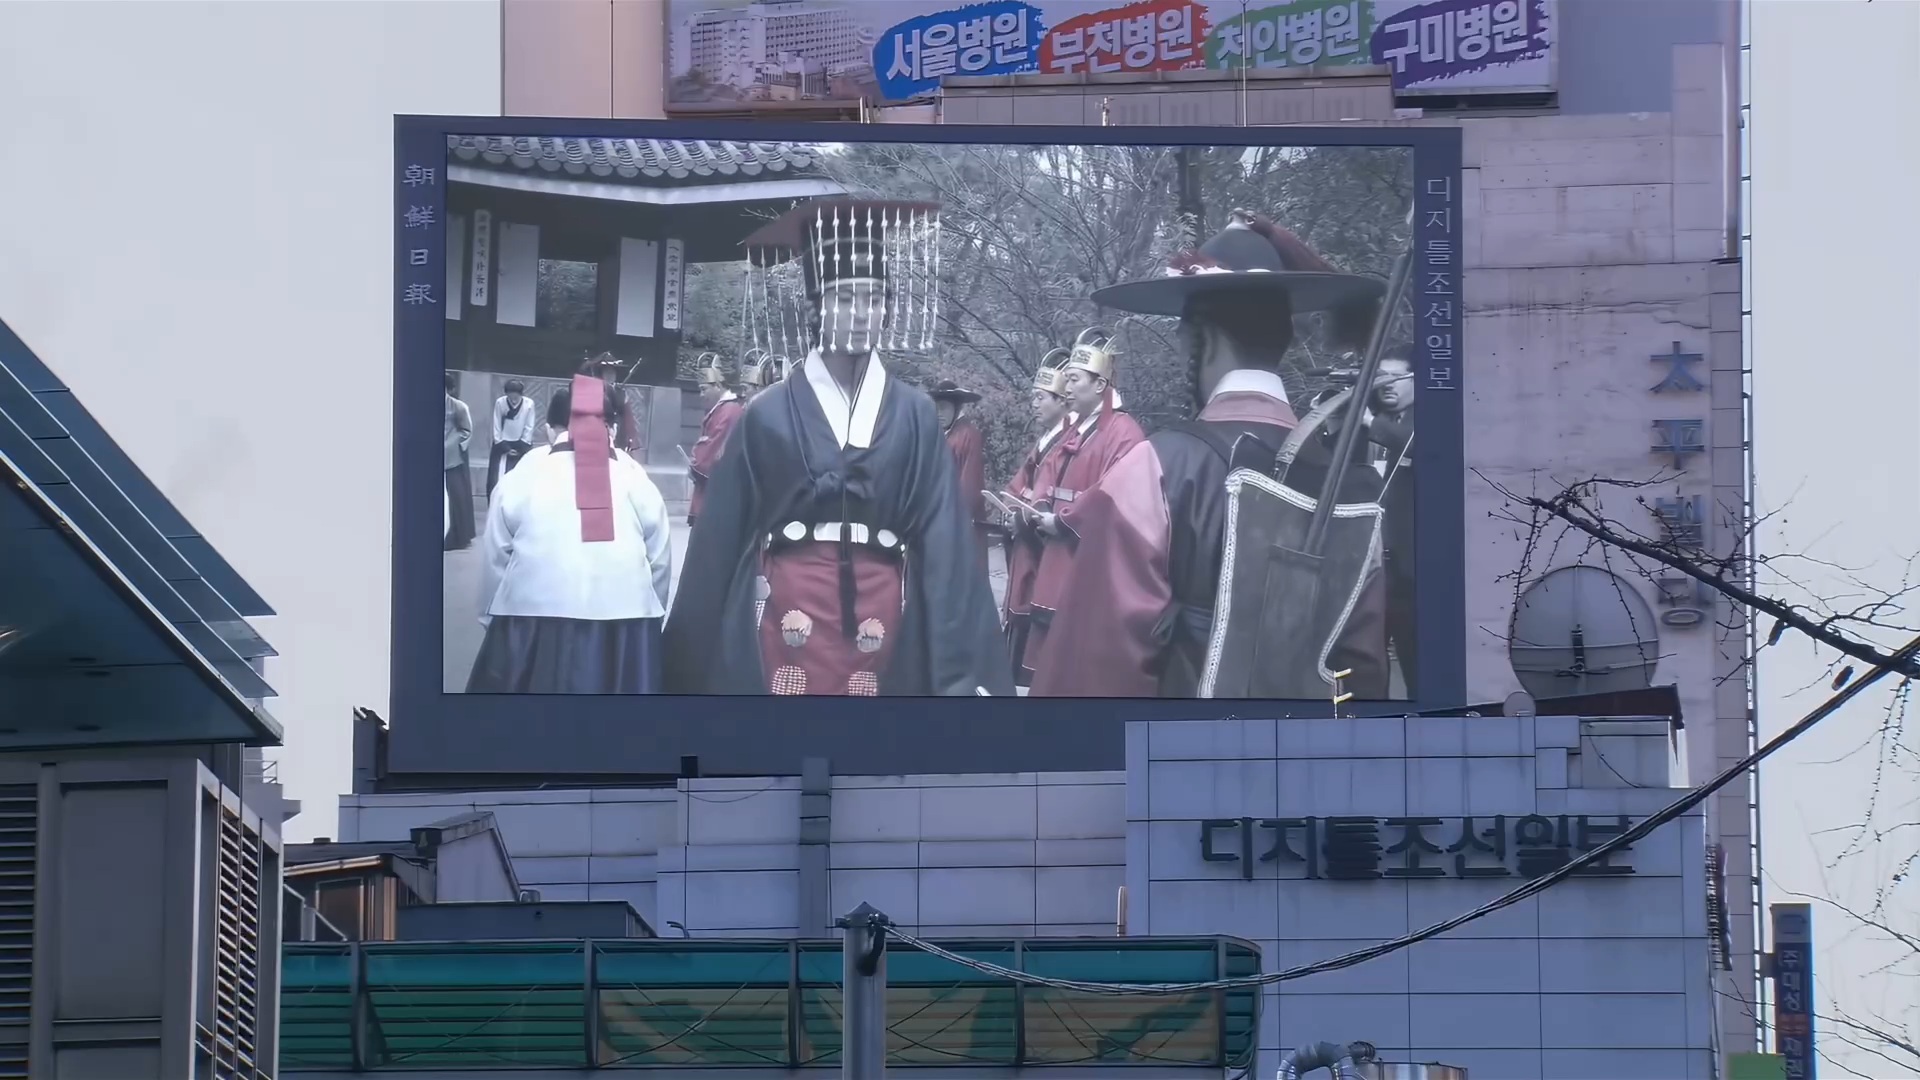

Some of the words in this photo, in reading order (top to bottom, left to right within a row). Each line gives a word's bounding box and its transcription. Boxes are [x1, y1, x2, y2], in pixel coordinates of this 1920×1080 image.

[886, 8, 1028, 81] 서울병원
[1050, 5, 1193, 74] 부천병원
[1215, 7, 1360, 70] 천안병원
[1383, 3, 1529, 74] 구미병원
[402, 163, 437, 305] 朝鮮日報
[1424, 176, 1456, 390] 디지틀조선일보
[1200, 814, 1636, 880] 디지틀조선일보
